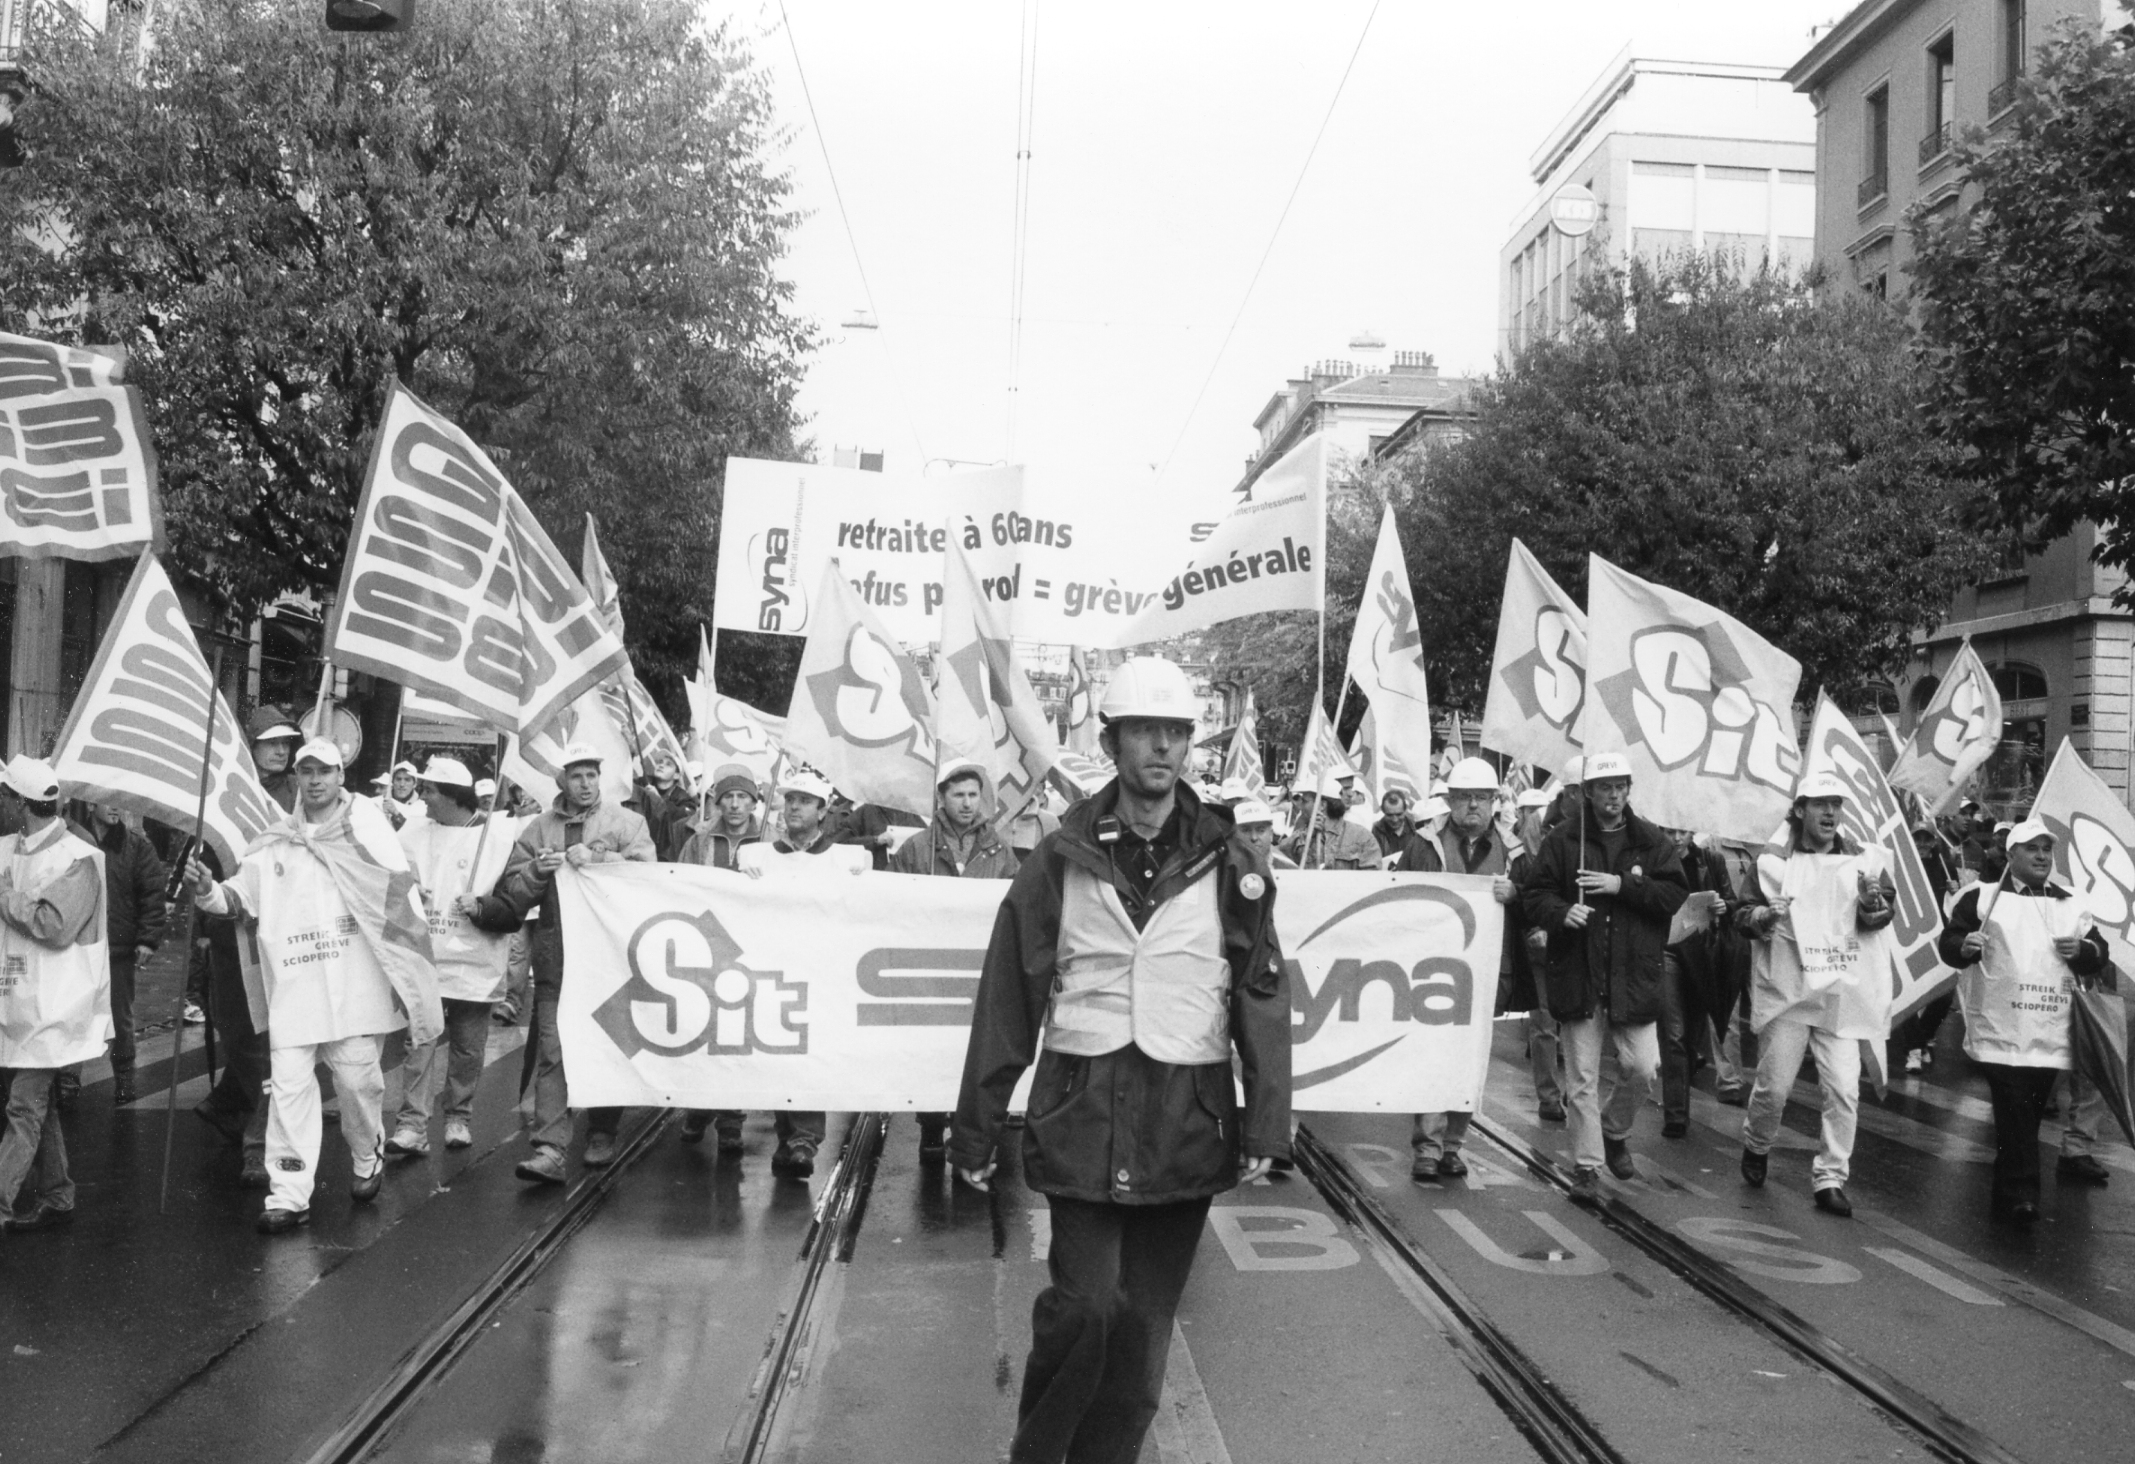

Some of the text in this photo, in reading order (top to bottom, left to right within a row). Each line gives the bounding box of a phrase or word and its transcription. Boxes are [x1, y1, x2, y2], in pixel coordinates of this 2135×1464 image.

[838, 517, 946, 554] retraite
[963, 515, 982, 551] à
[758, 527, 790, 632] syna
[1162, 536, 1312, 612] générale
[1627, 622, 1800, 801] Sit
[282, 950, 340, 967] SCIOPERO
[286, 929, 331, 945] STREIK
[627, 910, 809, 1058] Sit
[1284, 956, 1475, 1047] yna
[2011, 1001, 2059, 1013] SCIOPERO
[2019, 983, 2056, 994] STREIK
[1206, 1204, 1864, 1284] BUS
